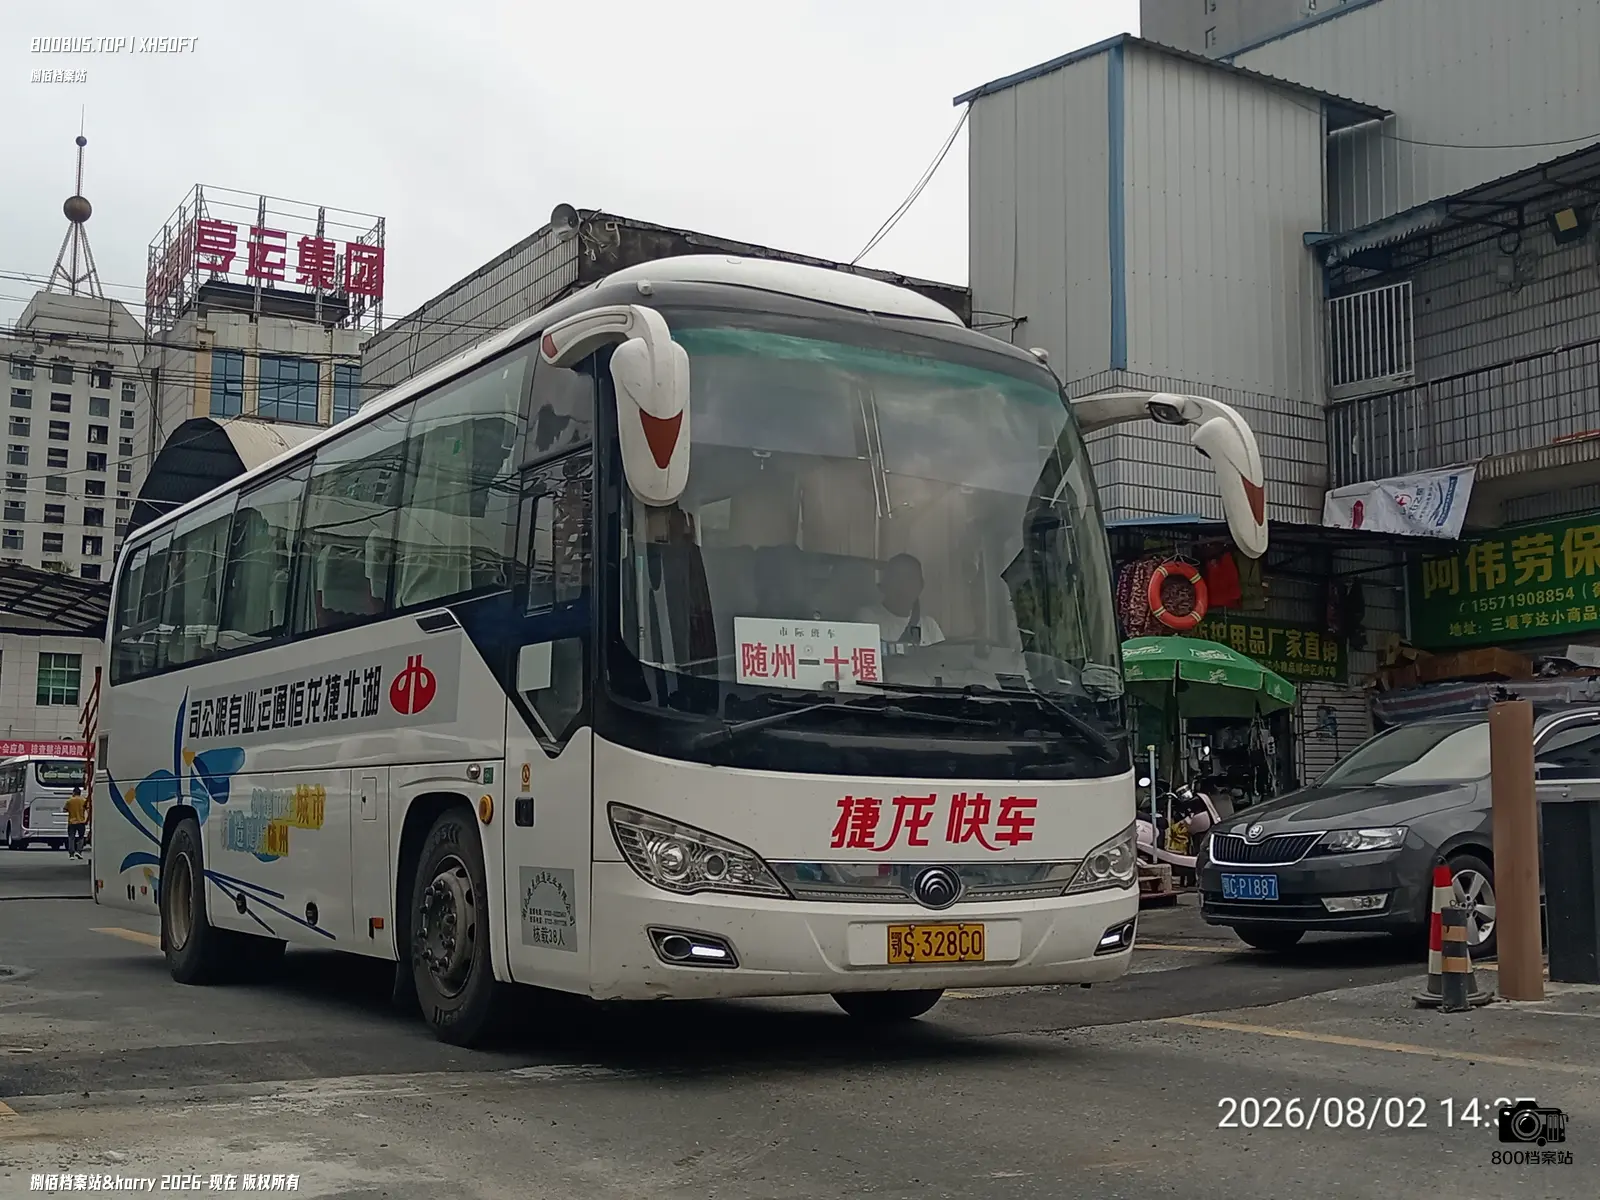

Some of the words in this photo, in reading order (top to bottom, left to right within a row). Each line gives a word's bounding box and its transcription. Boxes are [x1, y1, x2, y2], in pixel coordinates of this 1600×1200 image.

[196, 219, 385, 298] 亨运集团
[1421, 525, 1600, 599] 阿伟劳保
[1449, 605, 1600, 637] 地址：三堰亨达小商品
[1471, 586, 1575, 613] 15571908854
[189, 665, 382, 740] 湖北捷龙恒通运业有限公司
[0, 743, 25, 755] 会应急
[31, 743, 92, 757] 排查整治风险隐
[830, 792, 1038, 852] 捷龙快车
